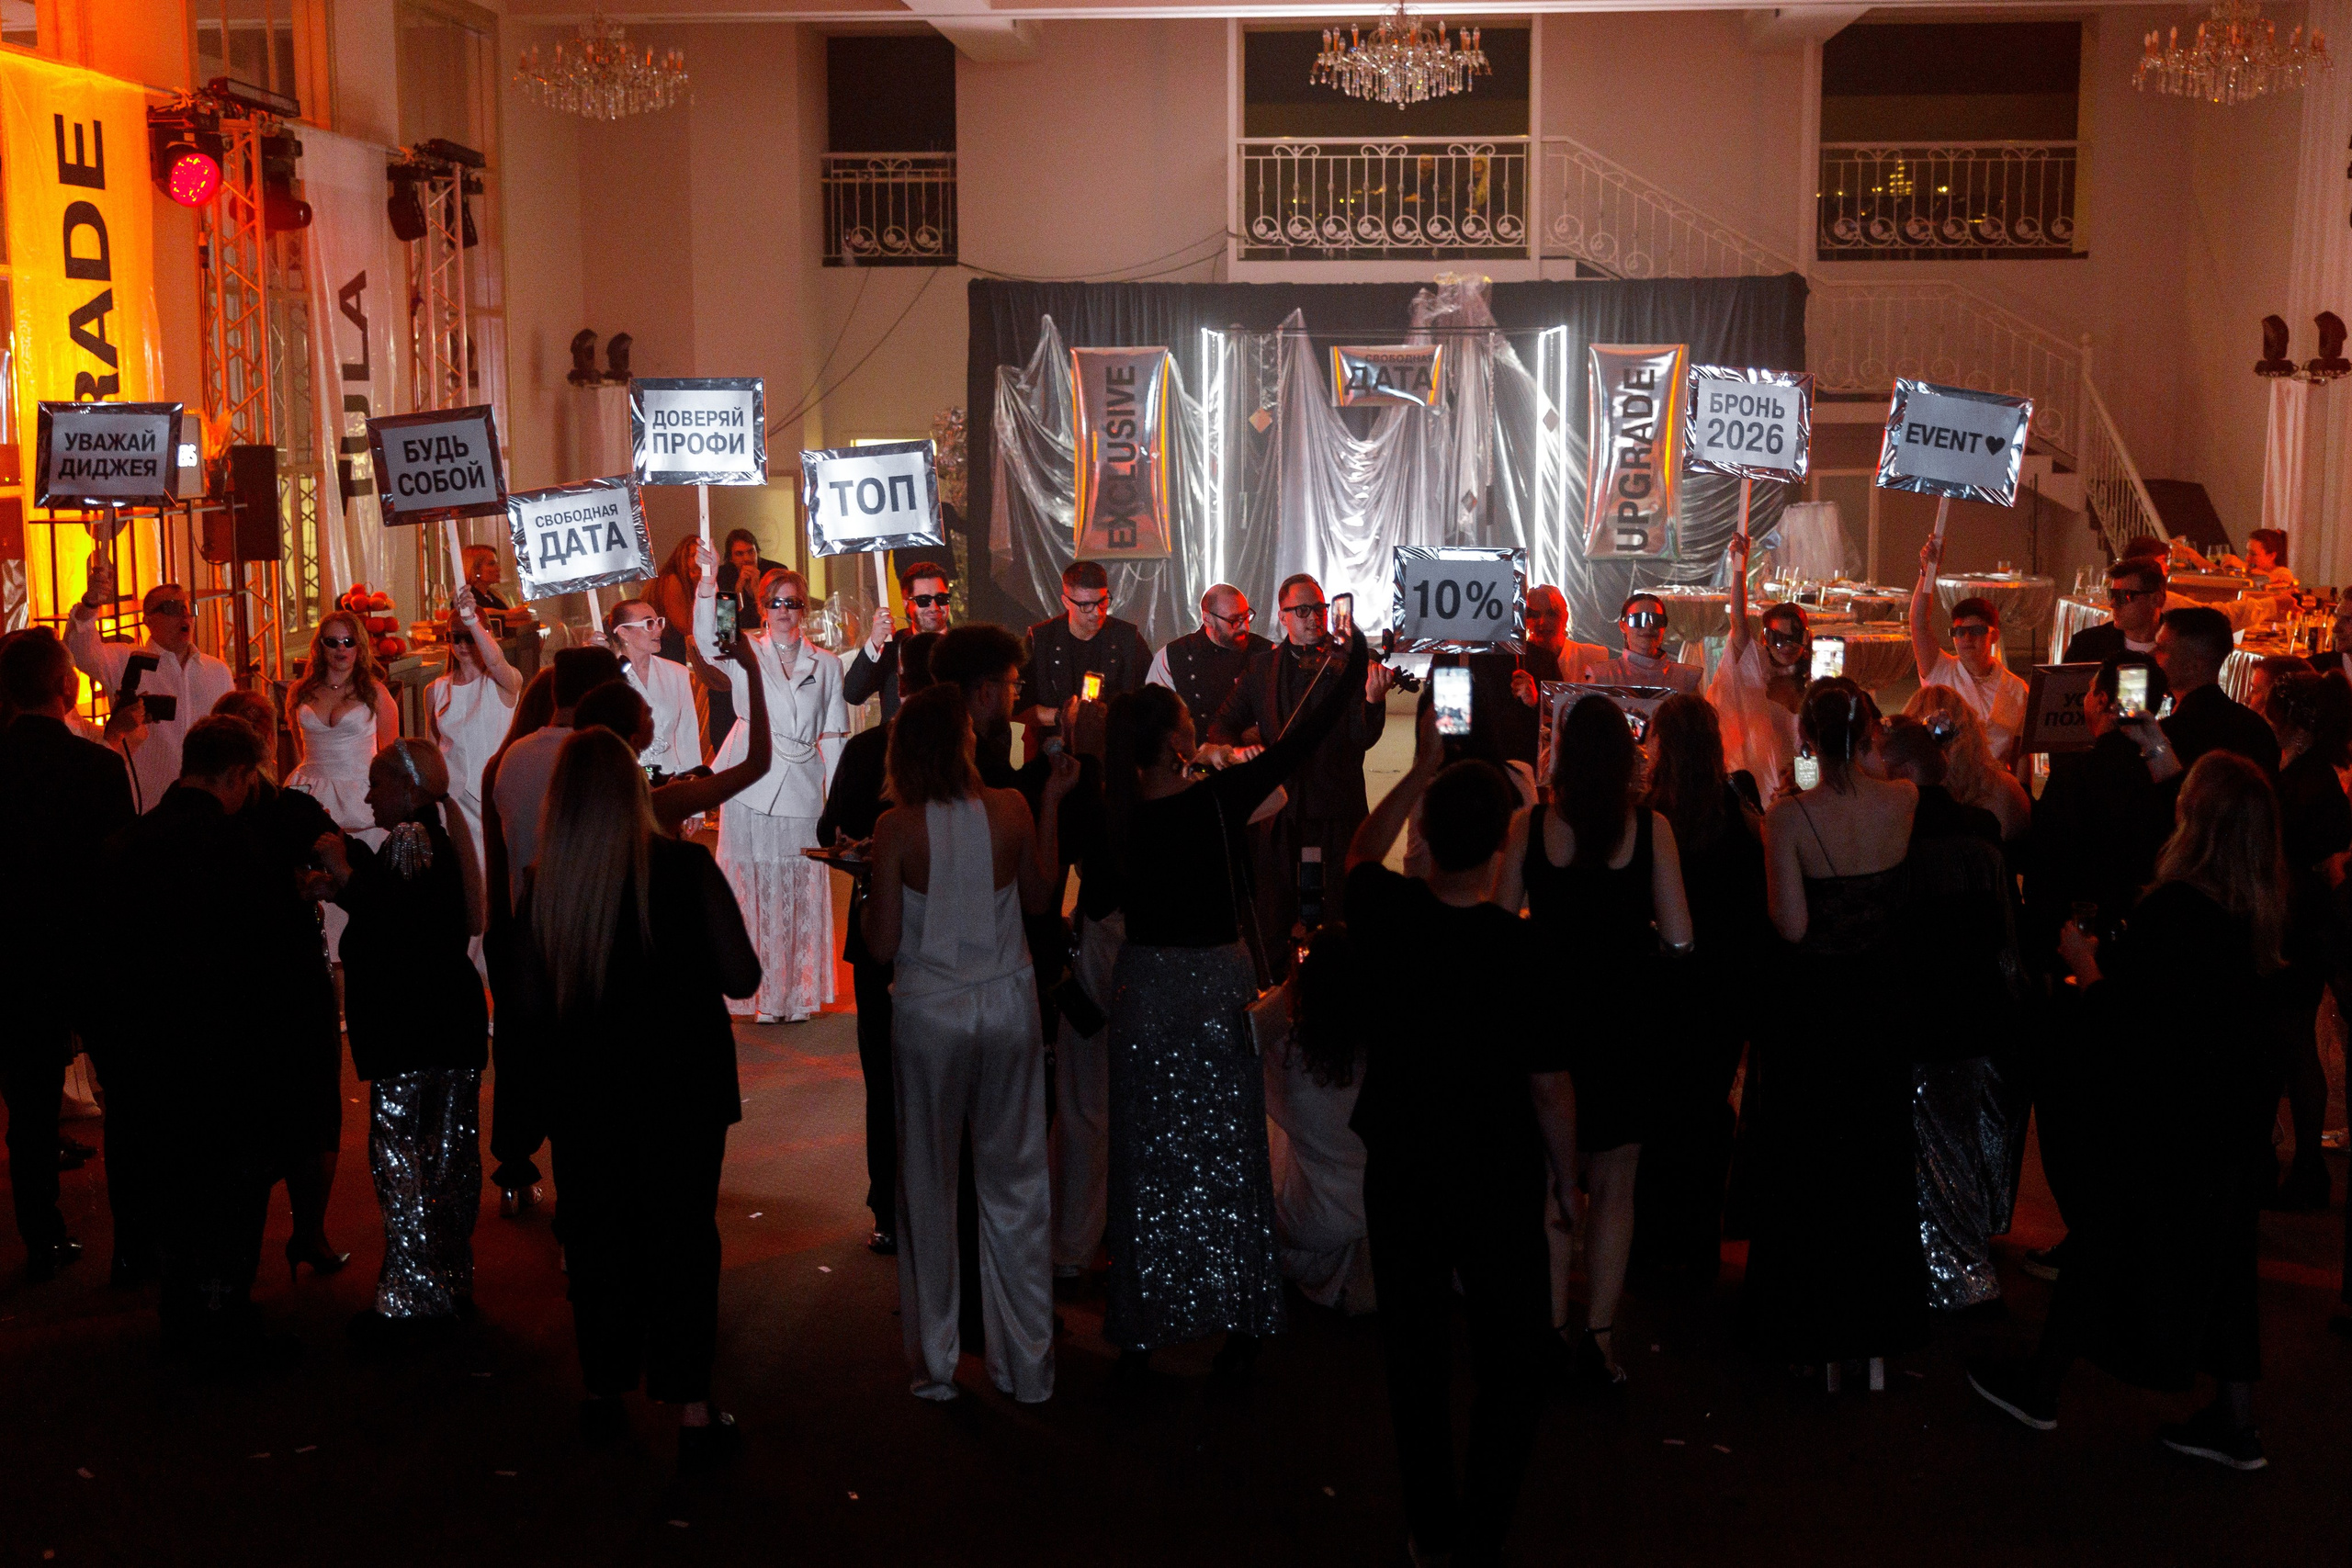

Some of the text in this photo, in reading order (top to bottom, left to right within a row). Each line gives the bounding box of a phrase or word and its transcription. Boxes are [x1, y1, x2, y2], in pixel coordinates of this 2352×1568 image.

[1365, 354, 1434, 364] СВОБОДНАЯ
[1344, 366, 1433, 395] ДАТА
[652, 407, 744, 428] ДОВЕРЯЙ
[1710, 392, 1785, 419] БРОНЬ
[64, 429, 156, 452] УВАЖАЙ
[402, 435, 469, 465] БУДЬ
[652, 432, 745, 456] ПРОФИ
[1707, 418, 1784, 455] 2026
[1905, 423, 1983, 454] EVENT
[58, 458, 157, 480] ДИДЖЕЯ
[1106, 366, 1136, 548] EXCLUSIVE
[1616, 368, 1655, 551] UPGRADE
[398, 460, 486, 497] СОБОЙ
[830, 474, 917, 516] ТОП
[535, 503, 618, 528] СВОБОДНАЯ
[539, 521, 628, 569] ДАТА
[1412, 579, 1503, 622] 10%
